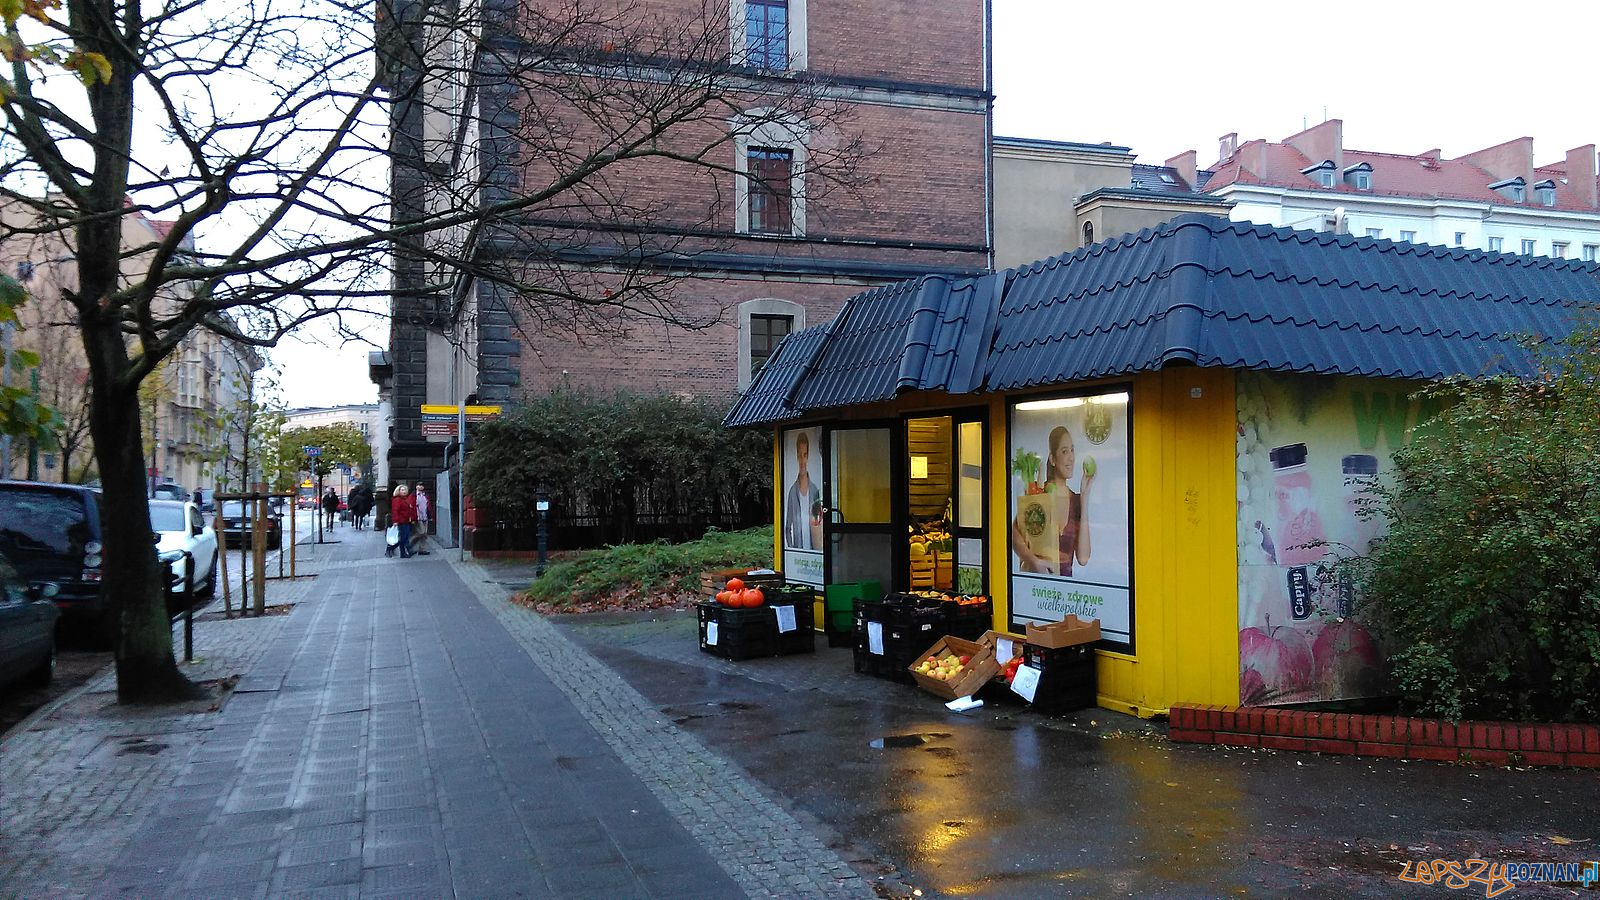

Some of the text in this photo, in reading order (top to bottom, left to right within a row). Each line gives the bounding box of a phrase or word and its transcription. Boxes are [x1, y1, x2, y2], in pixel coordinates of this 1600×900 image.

[1032, 585, 1104, 606] świeże, zdrowe
[1292, 572, 1305, 616] Cappy
[1037, 597, 1097, 618] wielkopolskie
